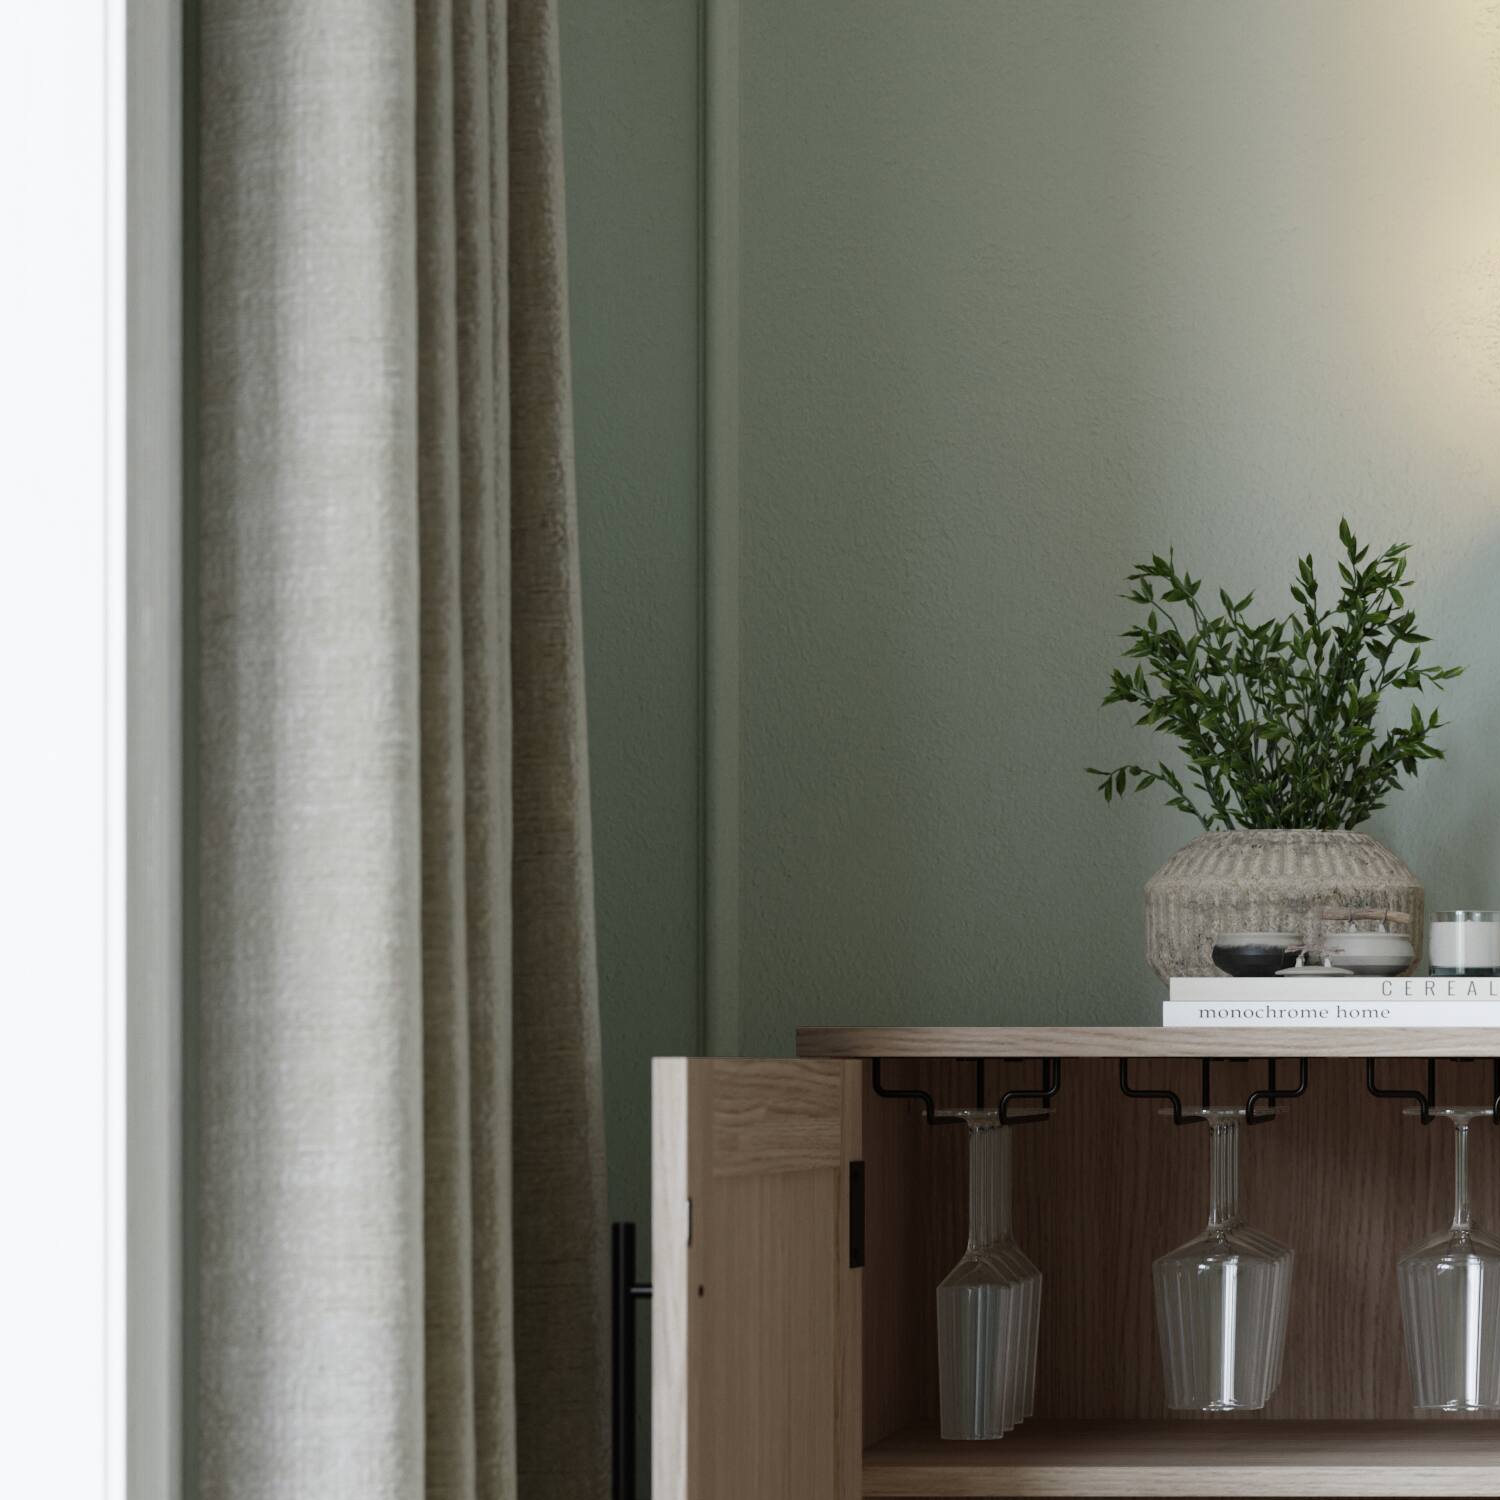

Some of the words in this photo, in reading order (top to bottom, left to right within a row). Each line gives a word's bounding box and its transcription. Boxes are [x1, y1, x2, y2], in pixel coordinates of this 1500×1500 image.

[1382, 980, 1498, 997] CEREAL
[1199, 1005, 1329, 1019] monochrome
[1337, 1005, 1390, 1019] home
